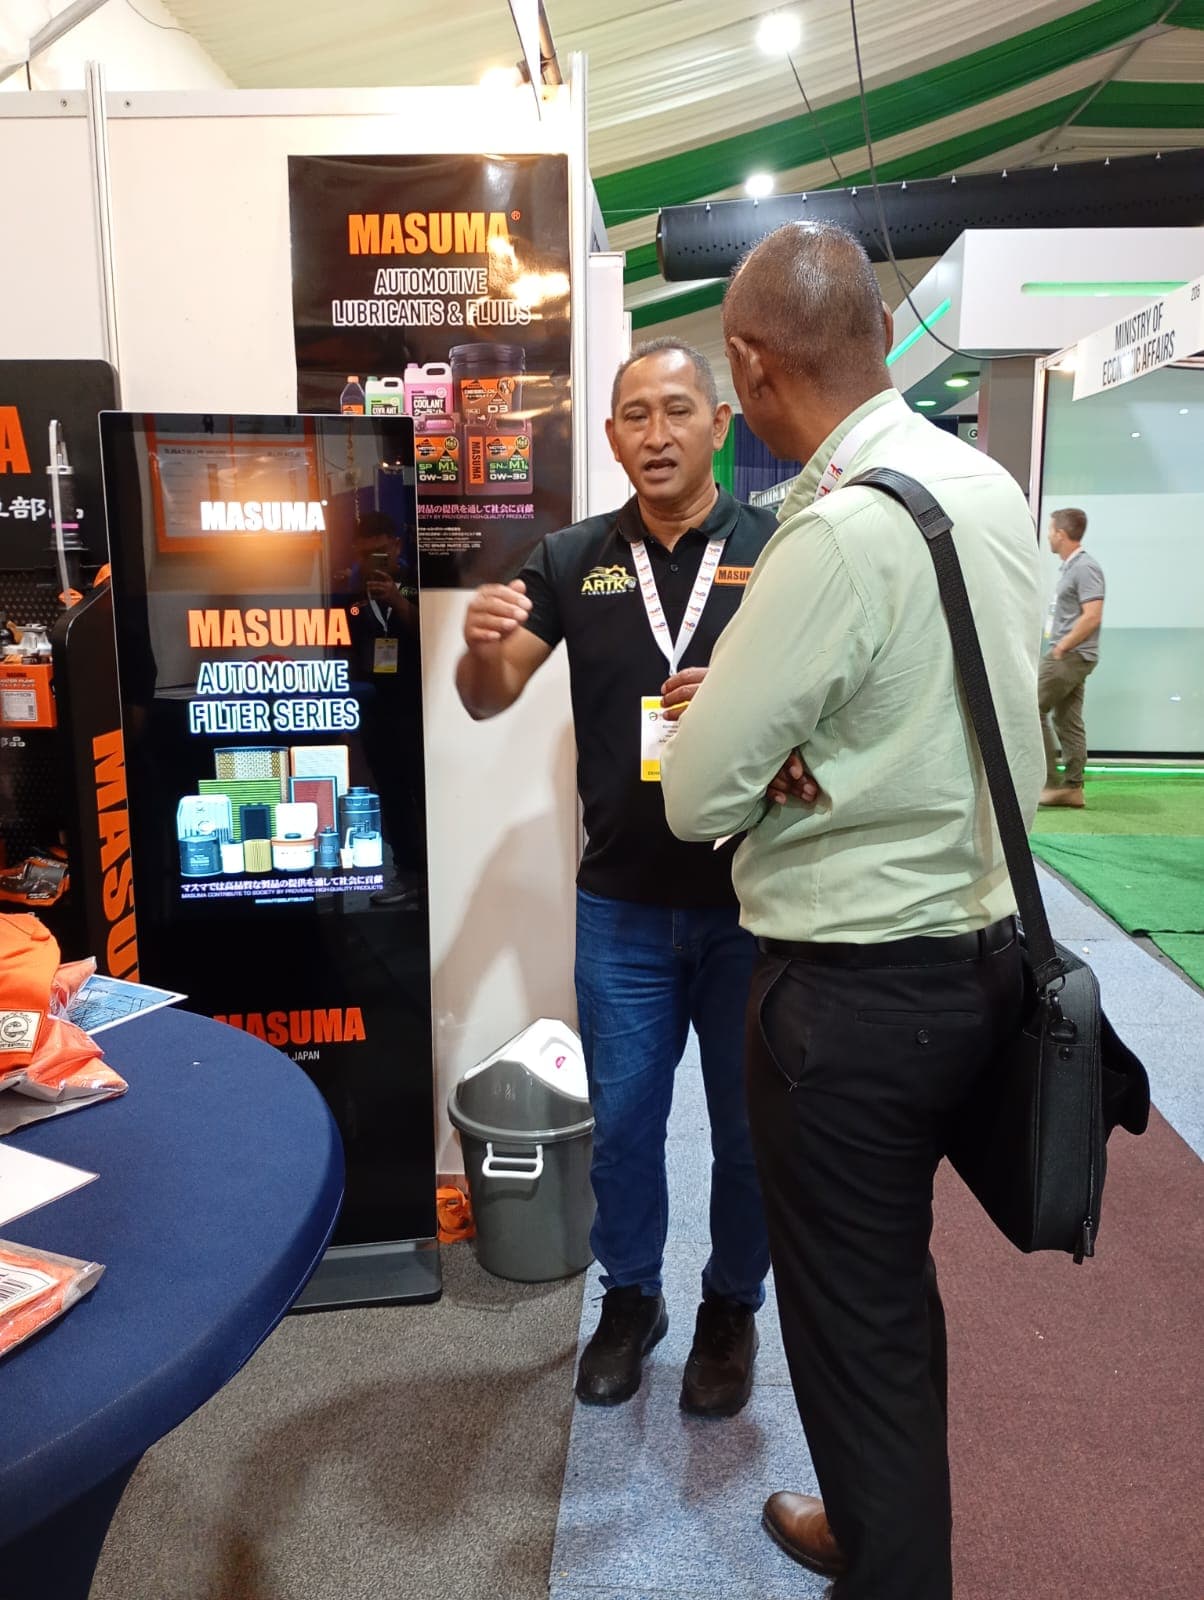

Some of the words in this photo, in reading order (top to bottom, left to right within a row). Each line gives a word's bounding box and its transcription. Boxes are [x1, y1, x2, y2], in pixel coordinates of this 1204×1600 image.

[349, 211, 513, 255] MASUMA
[374, 268, 488, 295] AUTOMOTIVE
[332, 300, 444, 326] LUBRICANTS
[447, 301, 463, 325] &
[466, 300, 531, 326] FLUIDS
[1114, 307, 1152, 351] MINISTRY
[1152, 302, 1164, 332] OF
[1102, 346, 1141, 386] ECONIC
[1141, 329, 1176, 371] AFFAIRS
[471, 441, 481, 480] MASUMA
[489, 473, 527, 481] 0W-30
[200, 501, 326, 531] MASUMA
[188, 609, 351, 647] MASUMA
[196, 660, 350, 695] AUTOMOTIVE
[189, 700, 271, 734] FILTER
[273, 698, 359, 732] SERIES
[93, 729, 140, 985] MASU
[291, 1050, 320, 1062] JAPAN
